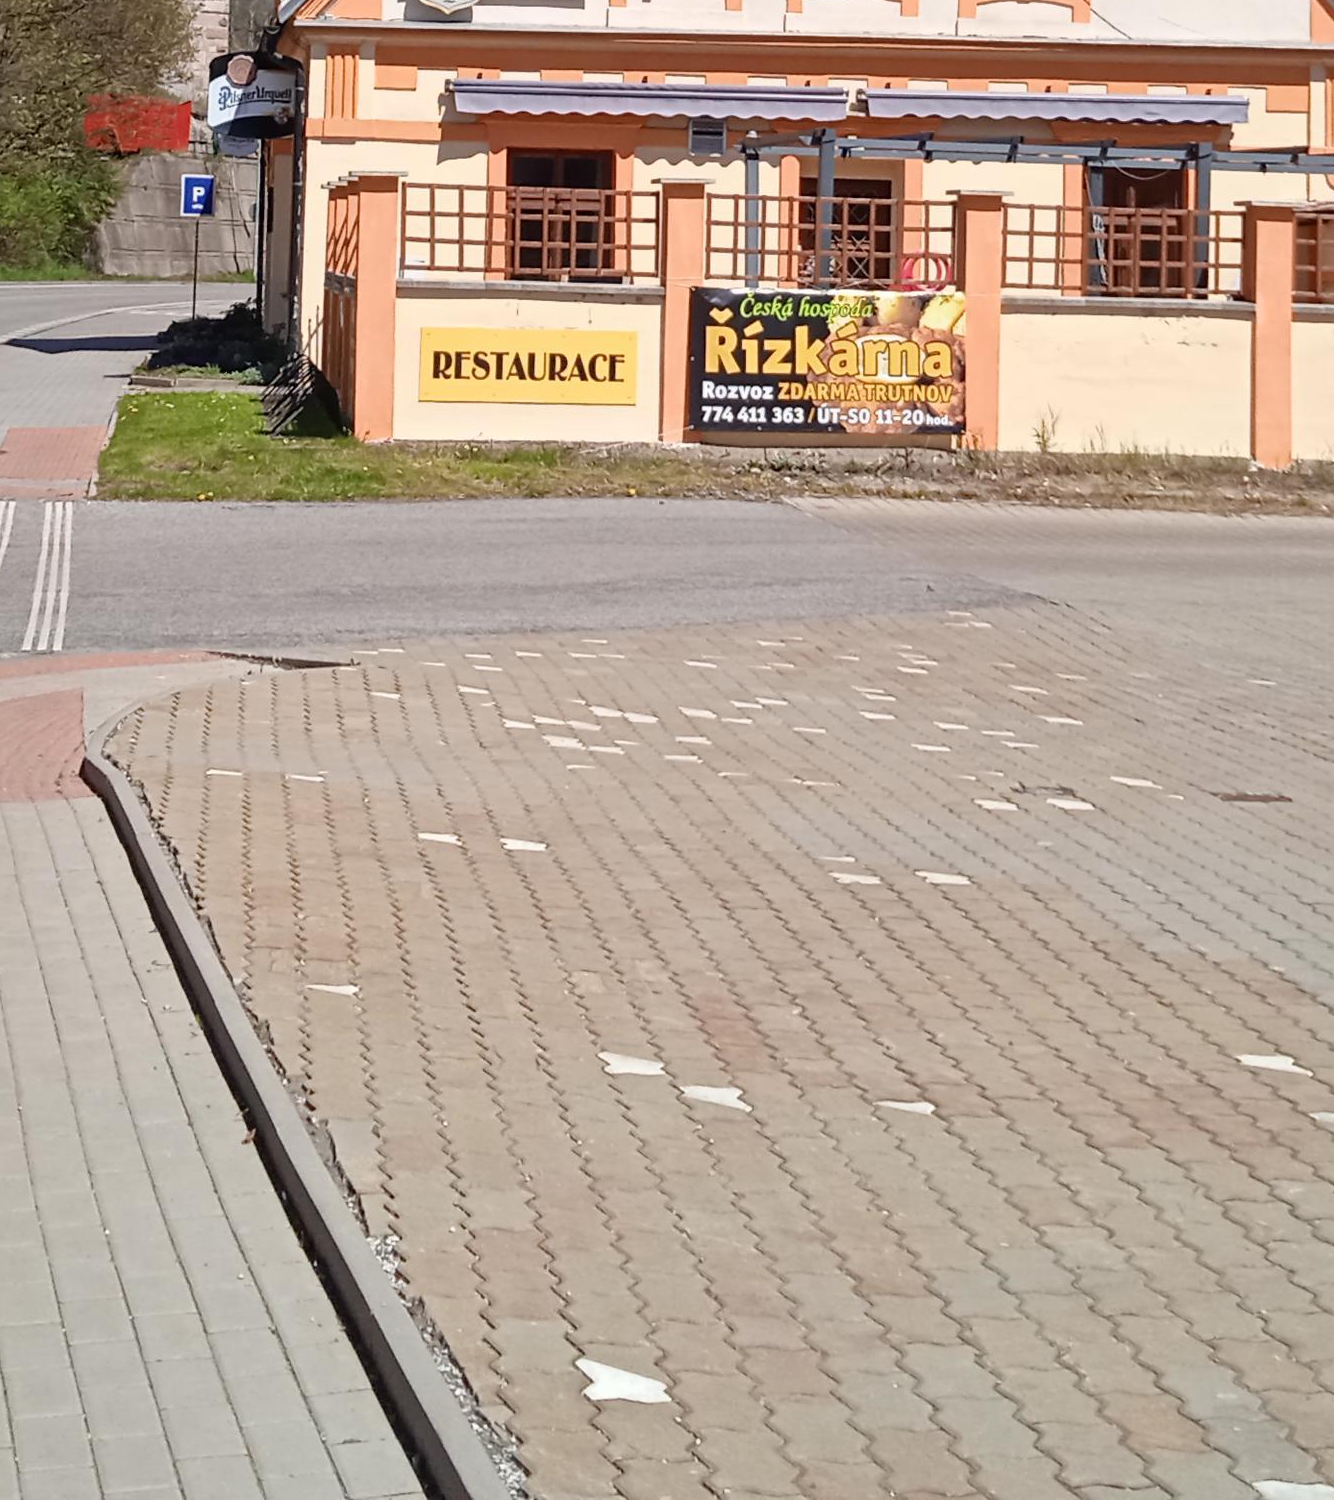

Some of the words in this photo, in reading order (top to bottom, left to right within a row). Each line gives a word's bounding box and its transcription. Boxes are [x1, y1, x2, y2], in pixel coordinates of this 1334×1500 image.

[218, 86, 256, 111] Pilsner
[255, 85, 292, 104] Urquell
[192, 186, 205, 203] P
[740, 291, 794, 321] Česká
[798, 295, 874, 324] hospoda
[704, 307, 954, 378] Řízkárna
[432, 350, 626, 382] RESTAURACE
[702, 380, 774, 399] Rozvoz
[778, 382, 860, 401] ZDARMA
[864, 383, 954, 403] TRUTNOV
[701, 405, 734, 422] 774
[737, 406, 767, 422] 411
[772, 406, 805, 423] 363
[817, 403, 871, 425] ÚT-SO
[875, 408, 924, 426] 11-20
[926, 414, 954, 427] hod.
